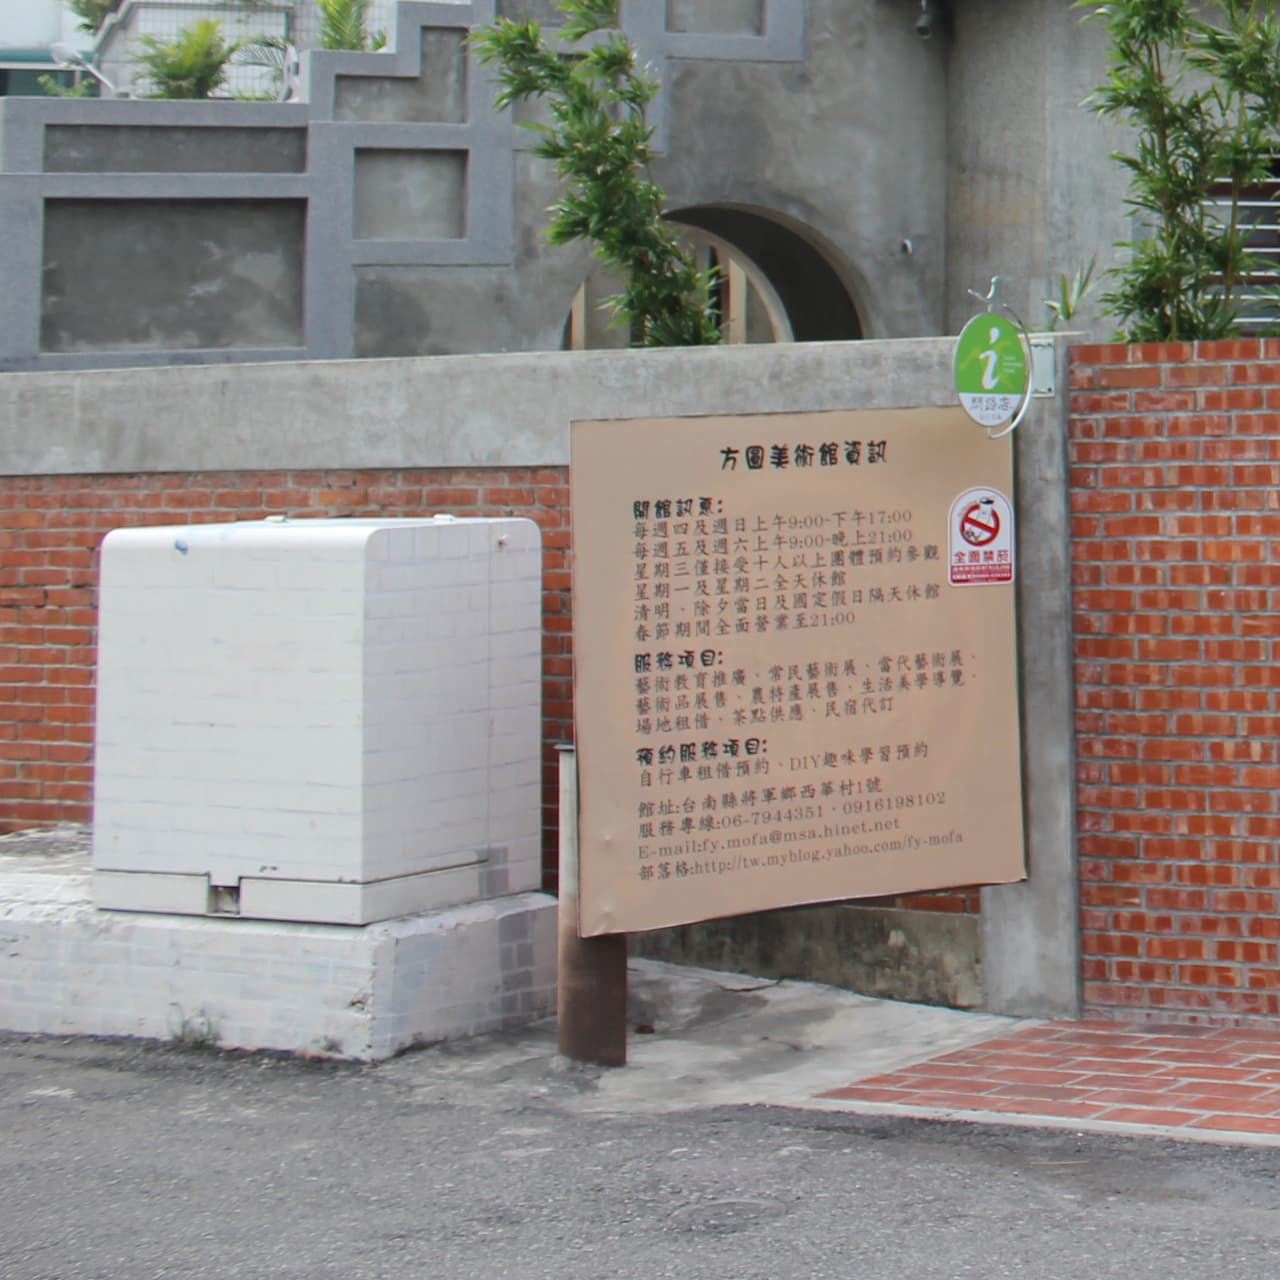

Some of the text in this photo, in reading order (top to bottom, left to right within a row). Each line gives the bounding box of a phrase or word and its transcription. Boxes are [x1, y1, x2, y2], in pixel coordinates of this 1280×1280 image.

[719, 440, 887, 470] 方圓美術館資訊
[633, 570, 846, 601] 星期一及星期二全天休館
[633, 611, 856, 642] 春節期間全面營業至21:00
